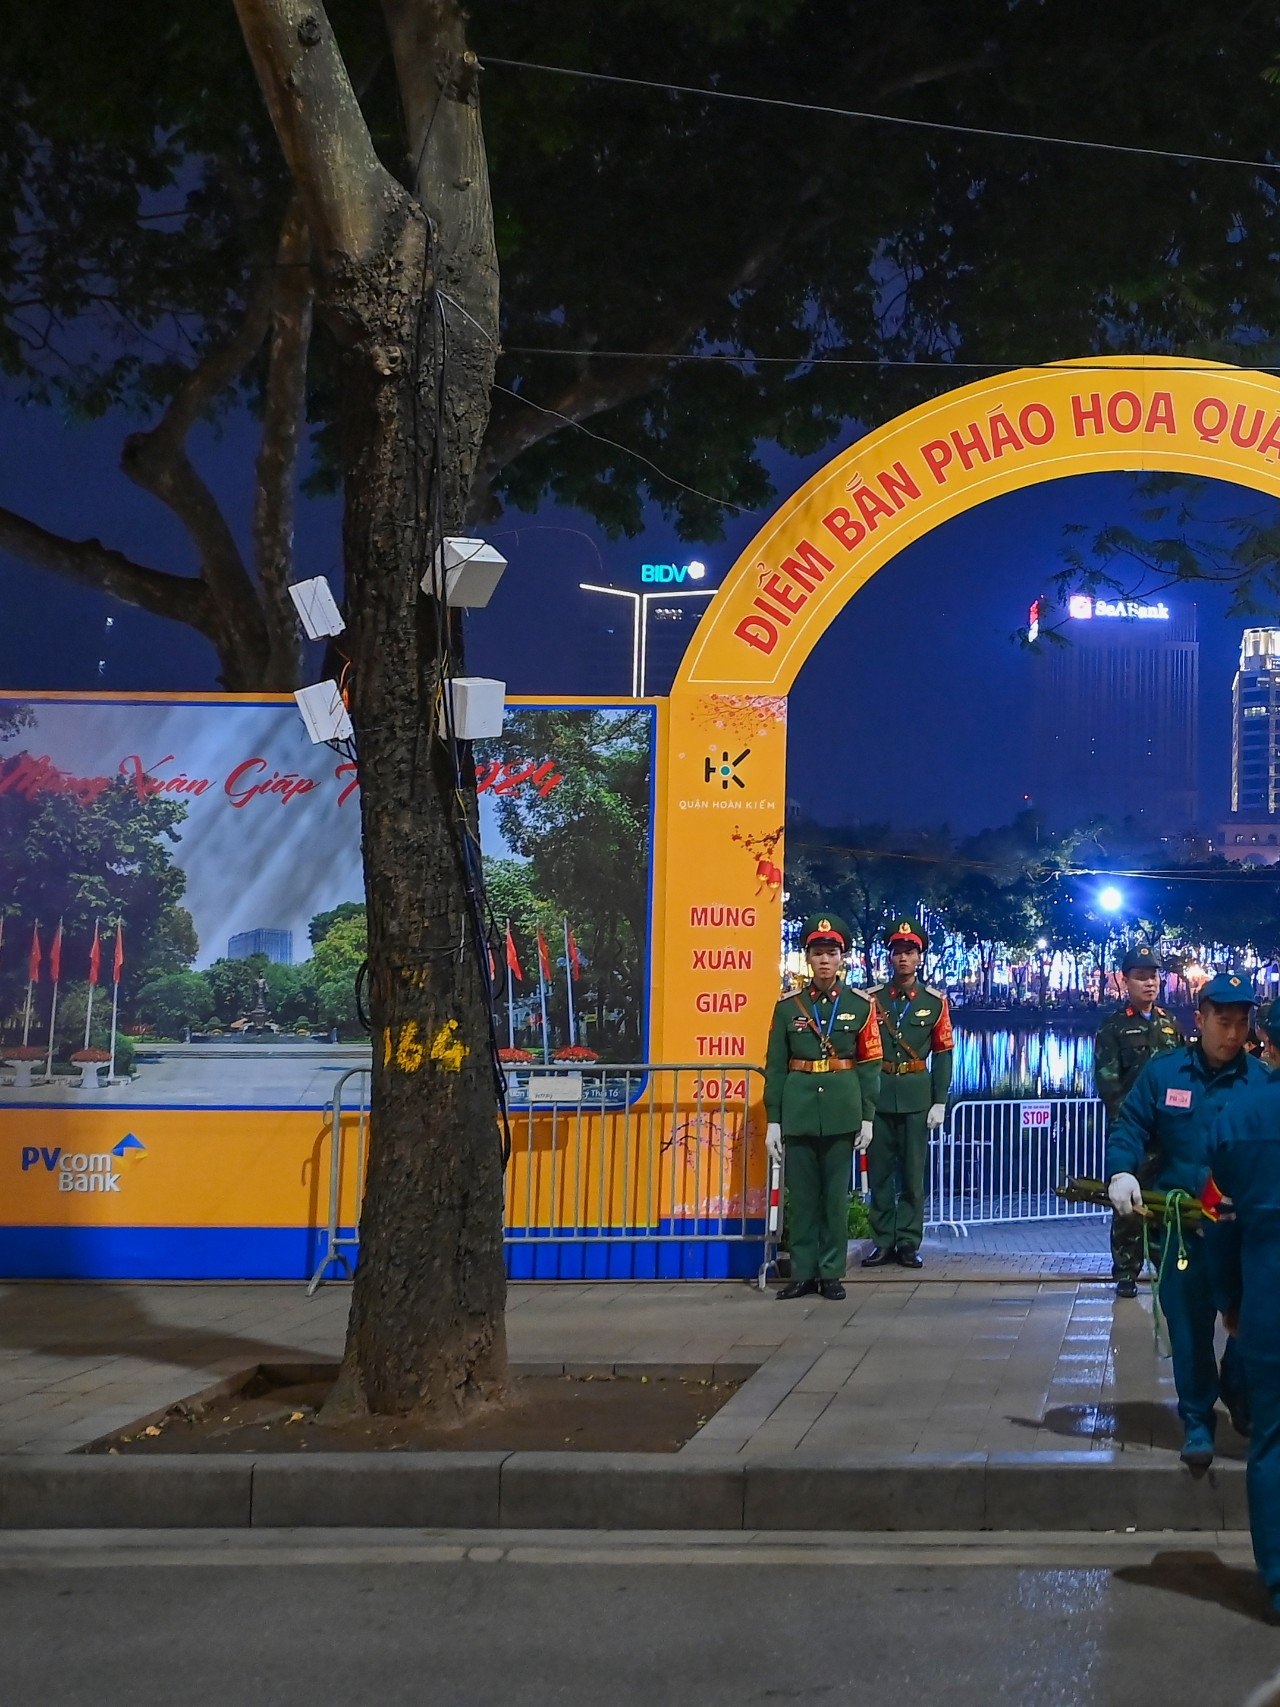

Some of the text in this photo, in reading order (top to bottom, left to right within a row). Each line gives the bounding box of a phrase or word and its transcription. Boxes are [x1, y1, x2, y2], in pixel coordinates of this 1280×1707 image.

[734, 539, 835, 655] ĐIỂM
[822, 461, 922, 551] BẮN
[919, 403, 1054, 484] PHÁO
[1070, 391, 1176, 436] HOA
[641, 563, 688, 583] BIDV
[224, 757, 321, 809] Giáp
[693, 1080, 747, 1099] 2024
[1023, 1111, 1049, 1125] STOP
[58, 1172, 121, 1193] Bank
